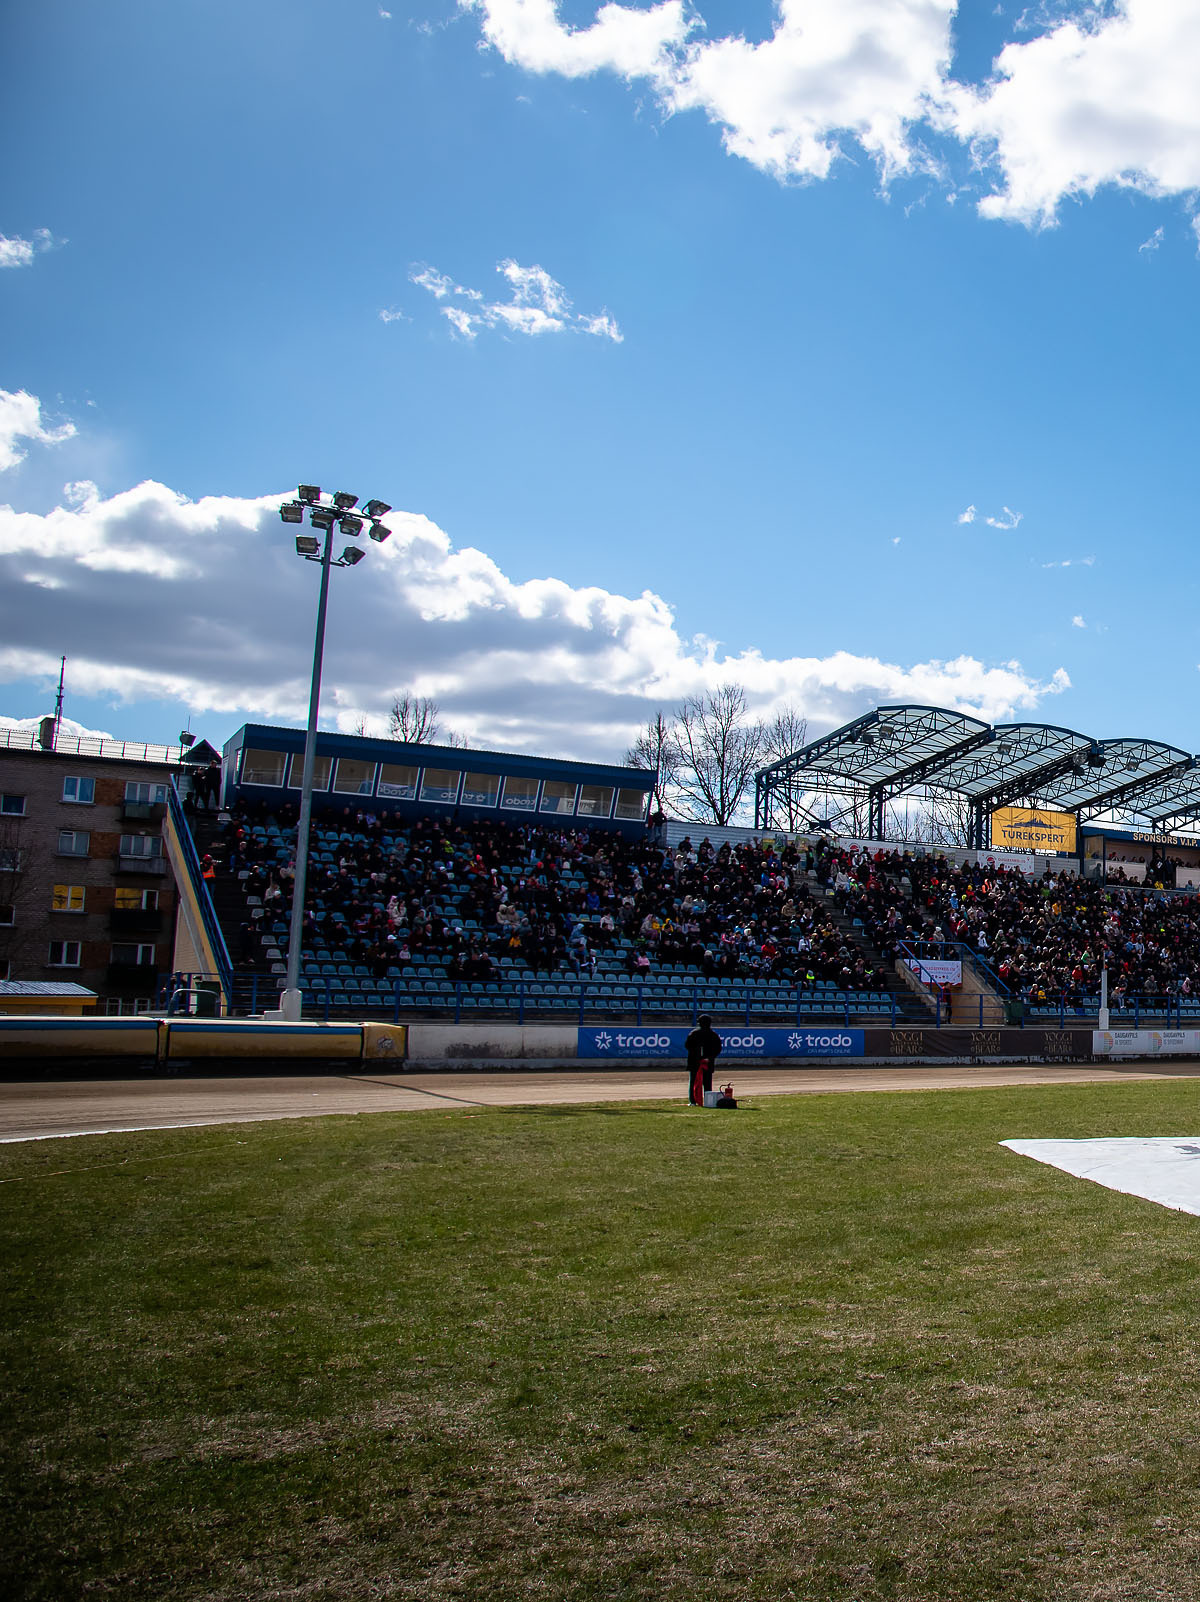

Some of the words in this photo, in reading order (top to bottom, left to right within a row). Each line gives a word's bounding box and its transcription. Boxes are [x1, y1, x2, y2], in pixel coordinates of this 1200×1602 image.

[1002, 830, 1065, 844] TUREKSPERT
[1133, 832, 1178, 845] SPONSORS
[1180, 837, 1198, 847] V.I.P.
[616, 1033, 671, 1048] trodo
[805, 1034, 852, 1048] trodo
[890, 1031, 923, 1042] YOGGI
[971, 1031, 1001, 1042] YOGGI
[1045, 1031, 1073, 1042] YOGGI
